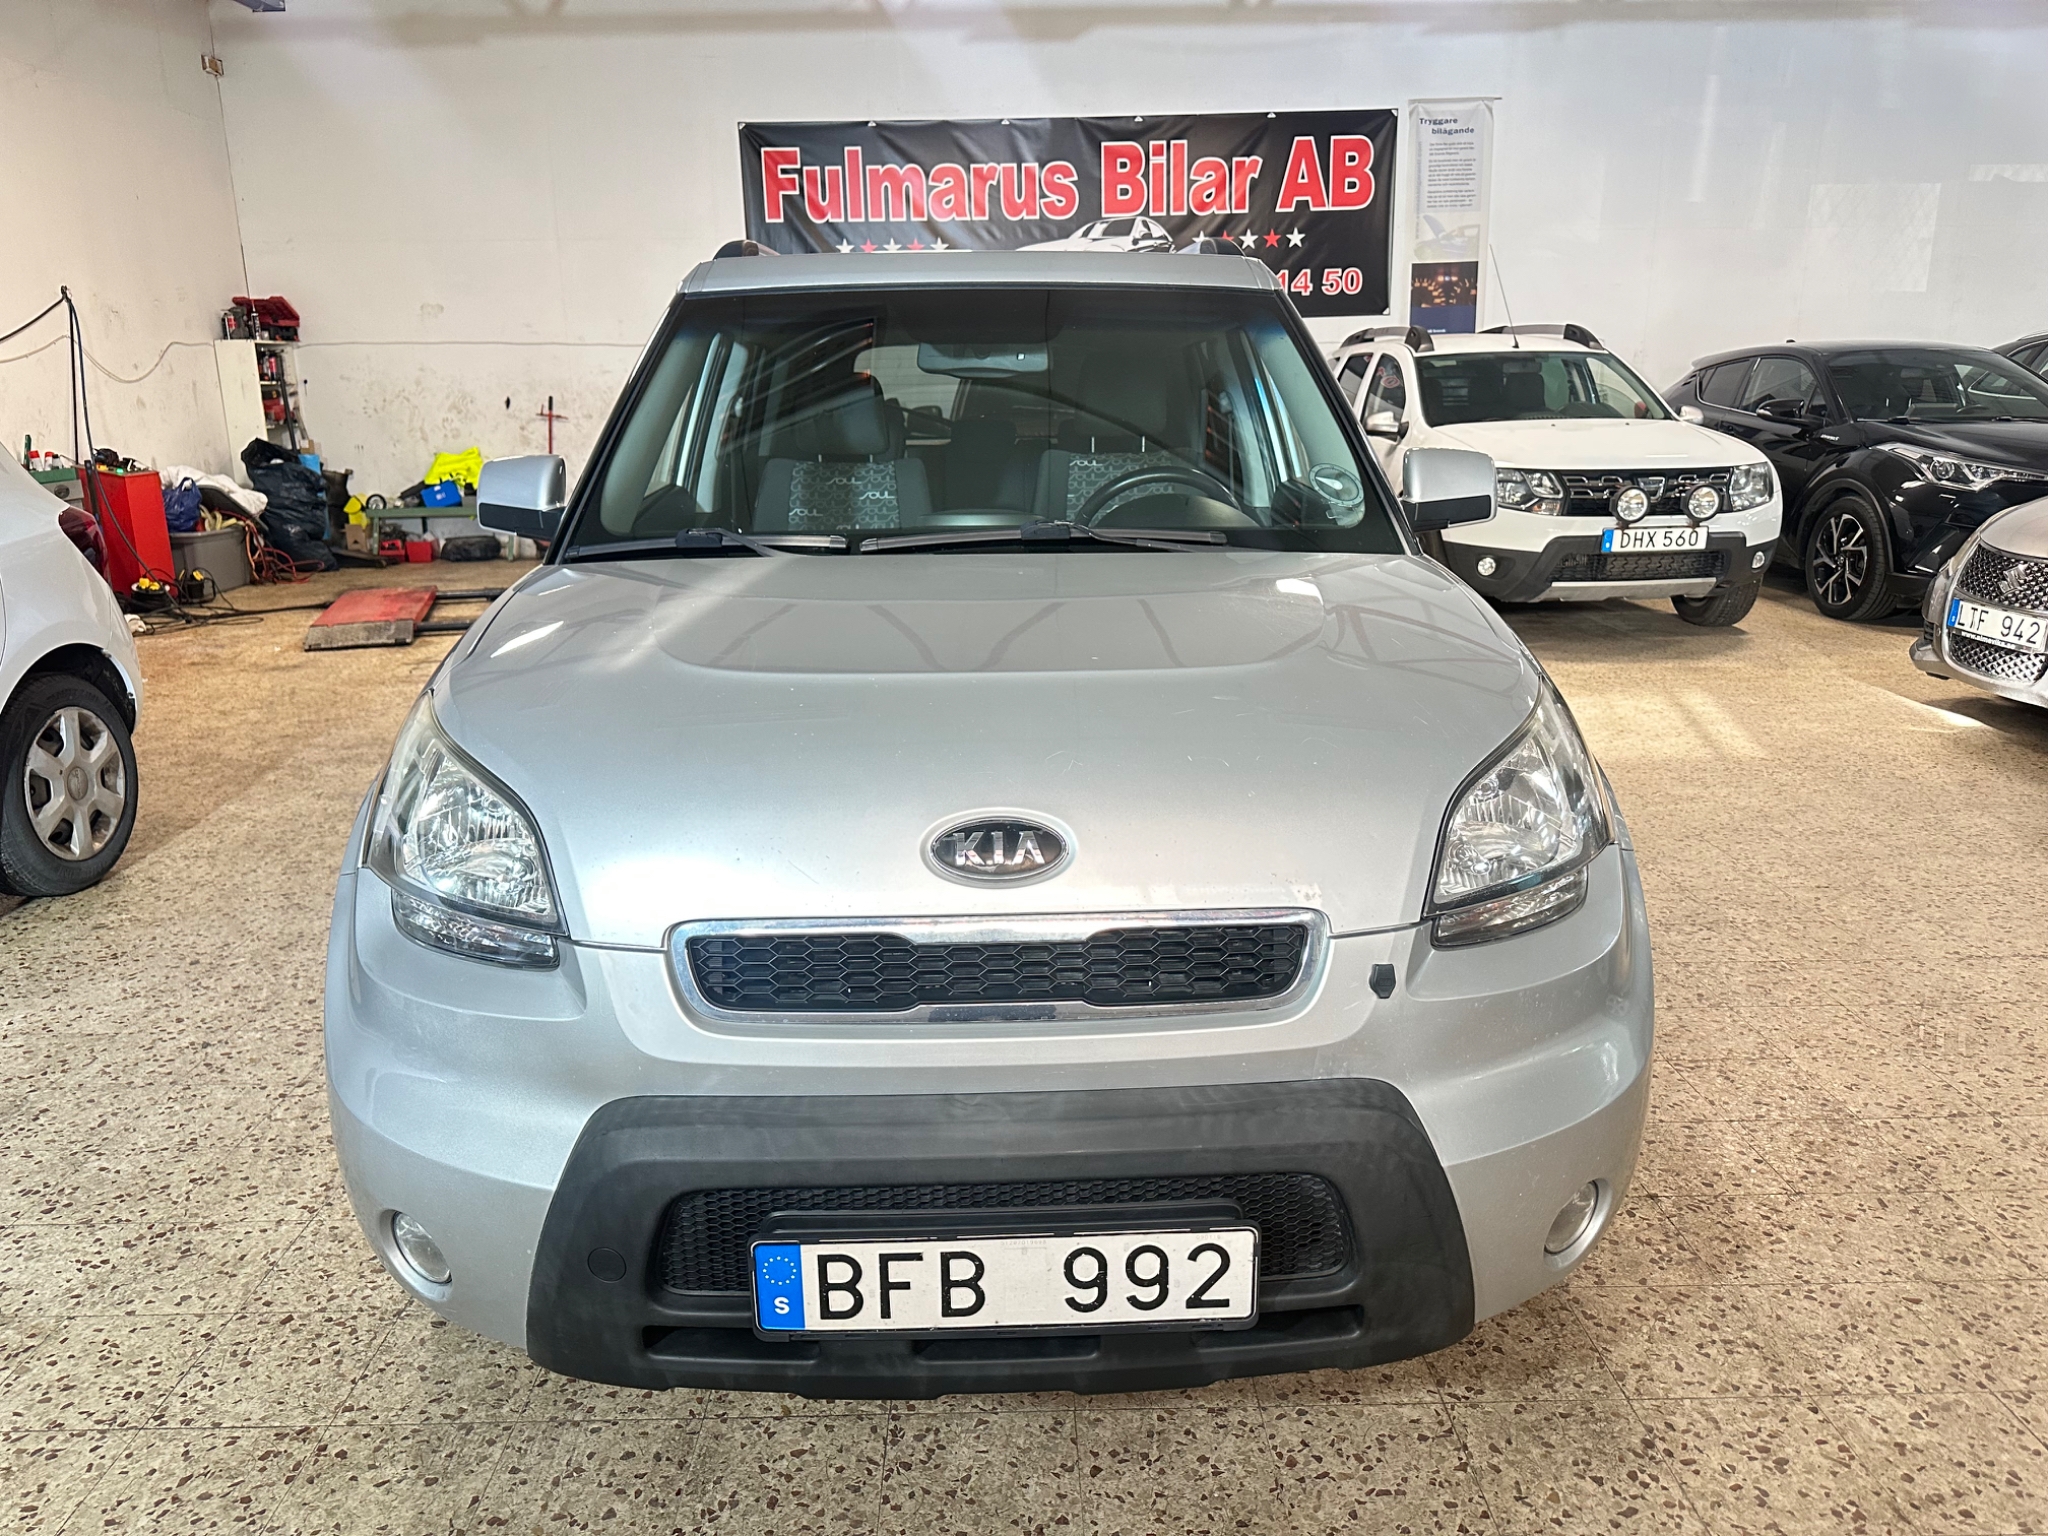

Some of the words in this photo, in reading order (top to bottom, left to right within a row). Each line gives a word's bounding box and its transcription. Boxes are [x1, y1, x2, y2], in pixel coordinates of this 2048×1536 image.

[1419, 117, 1458, 126] Tryggare
[760, 144, 1080, 224] Fulmarus
[1101, 140, 1264, 217] Bilar
[1275, 135, 1376, 213] AB
[1321, 266, 1363, 296] 50
[1619, 530, 1657, 550] DHX
[1662, 529, 1699, 548] 560
[1956, 603, 1989, 632] LTF
[2000, 614, 2041, 645] 942
[952, 830, 1046, 866] KIA
[816, 1250, 986, 1321] BFB
[1062, 1242, 1232, 1314] 992
[773, 1296, 790, 1315] S
